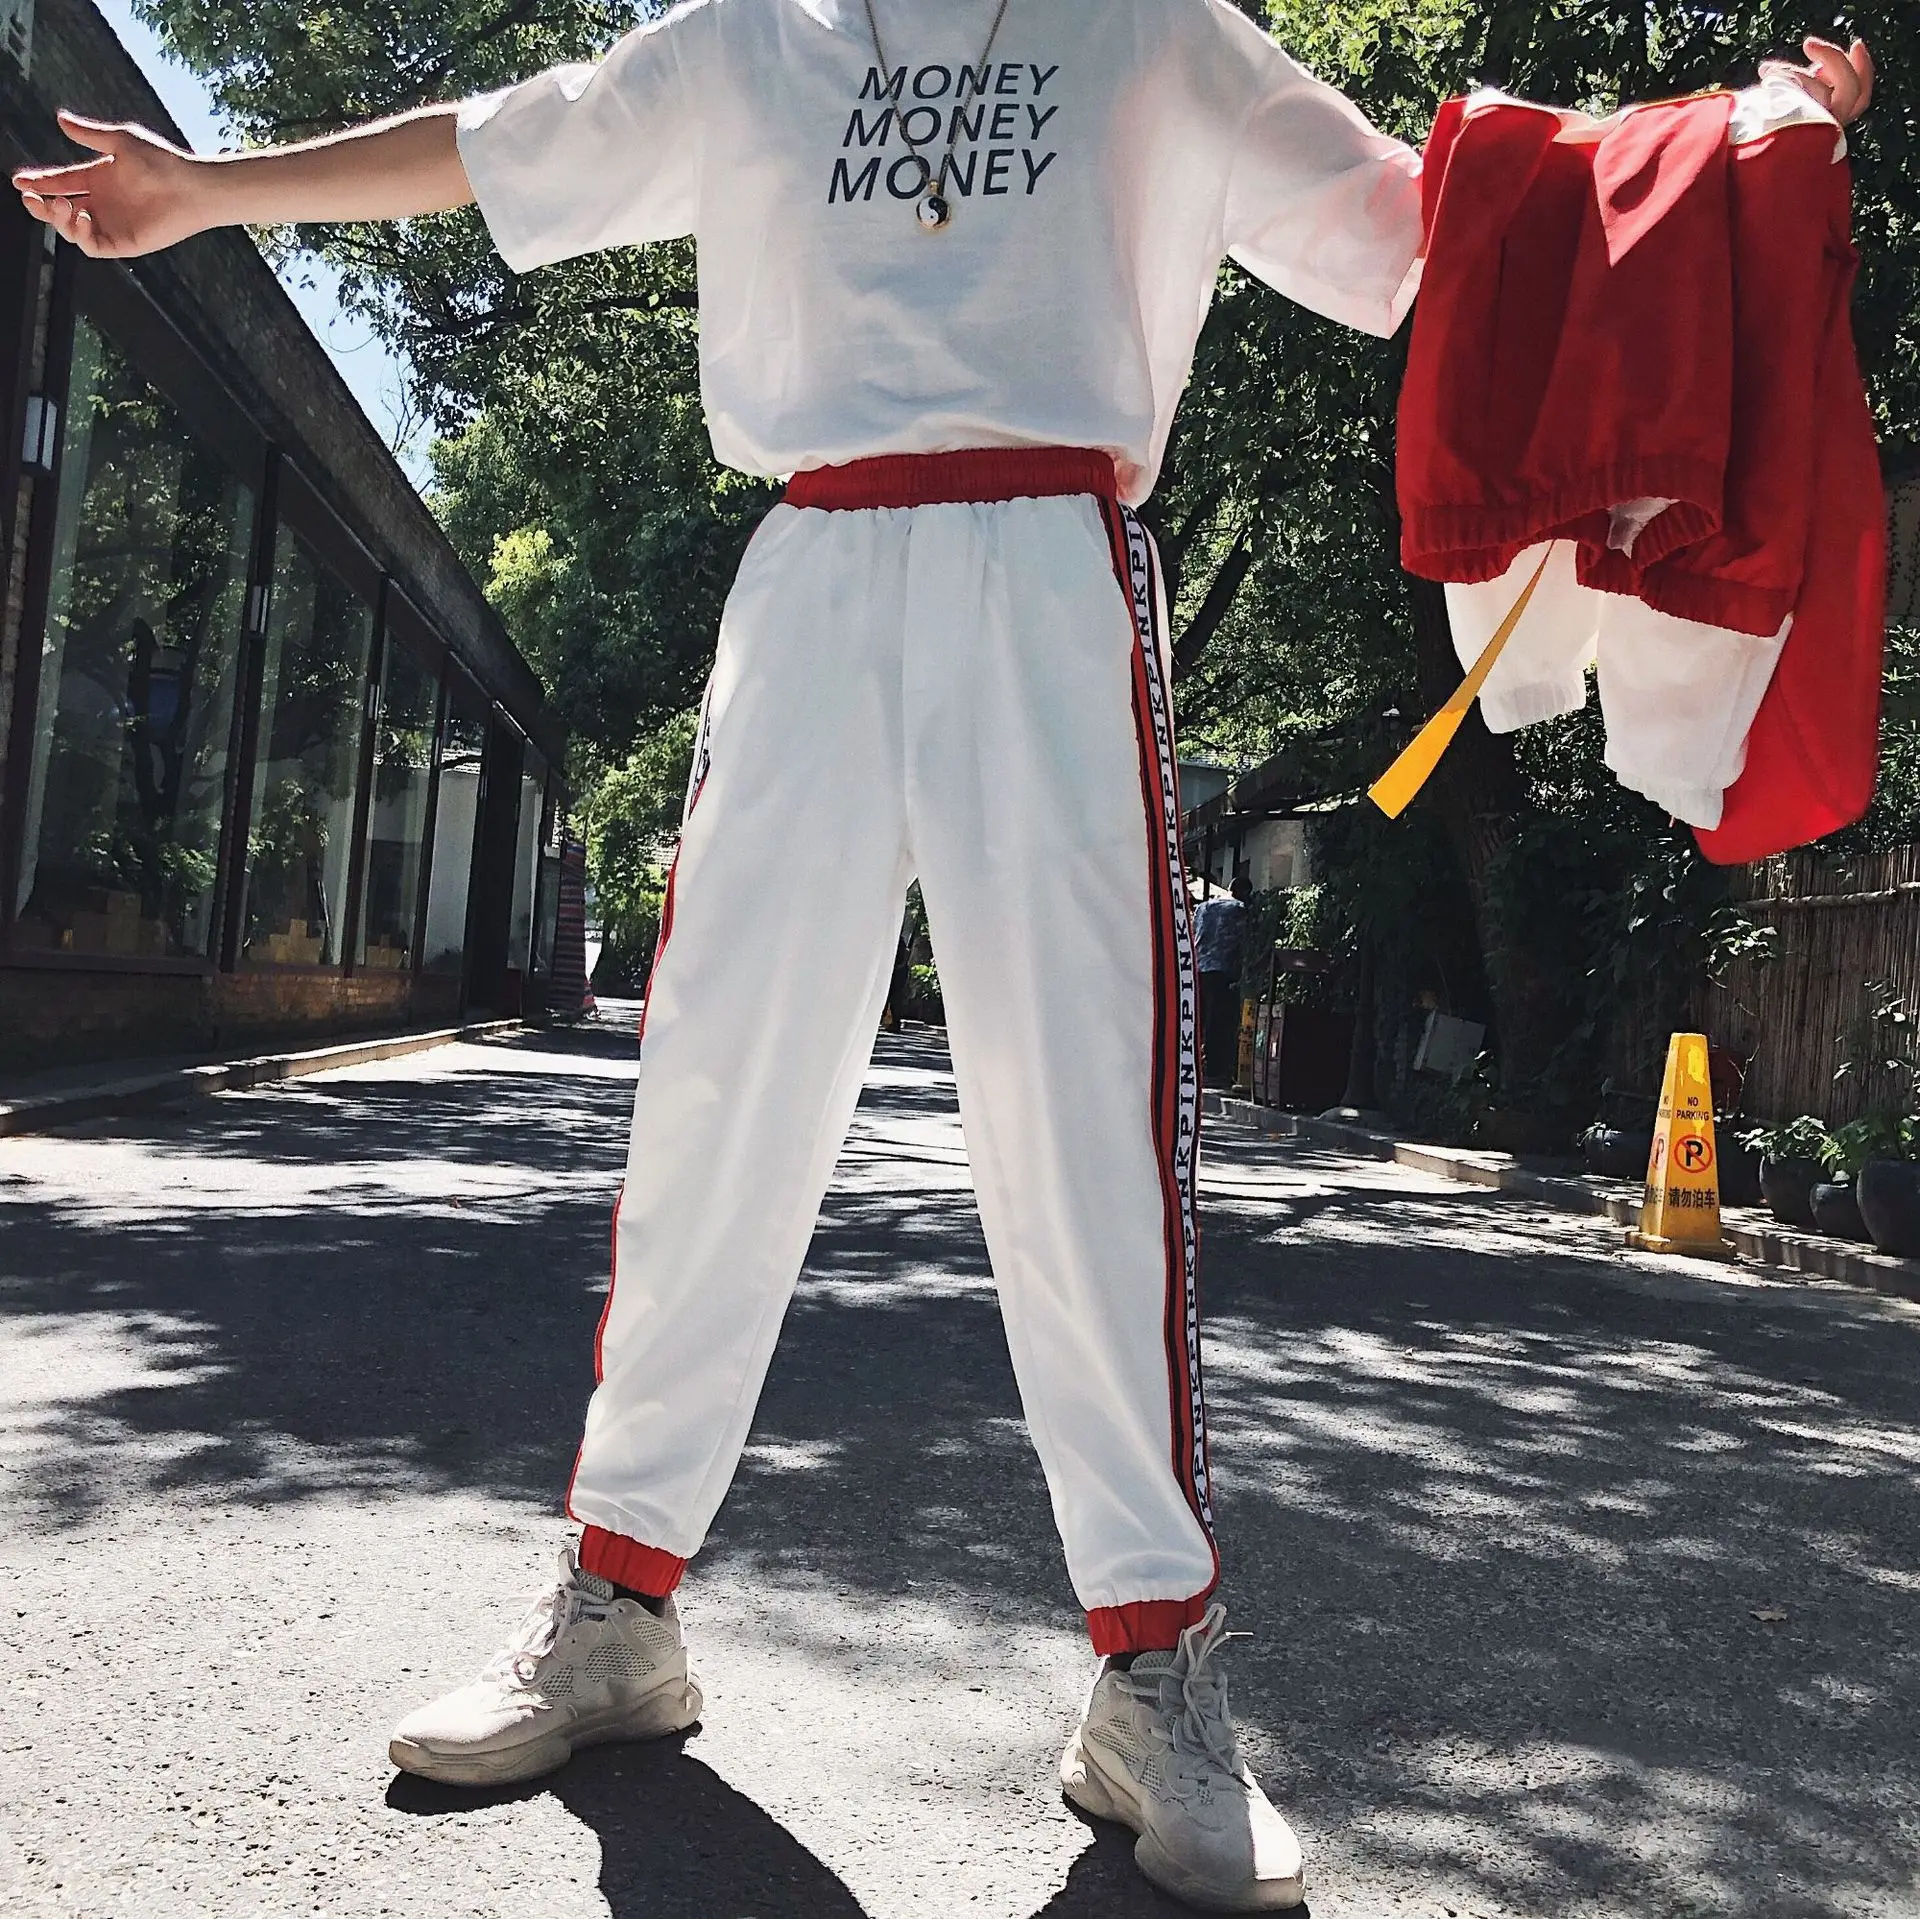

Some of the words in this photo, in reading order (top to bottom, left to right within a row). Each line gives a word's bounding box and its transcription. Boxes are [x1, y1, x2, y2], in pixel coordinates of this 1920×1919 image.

[858, 63, 1059, 101] MONEY
[842, 103, 1059, 148] MONEY
[828, 149, 1058, 204] MONEY
[1676, 1110, 1710, 1121] PARKING
[1687, 1096, 1699, 1107] NO
[1669, 1187, 1716, 1209] 请勿泊车
